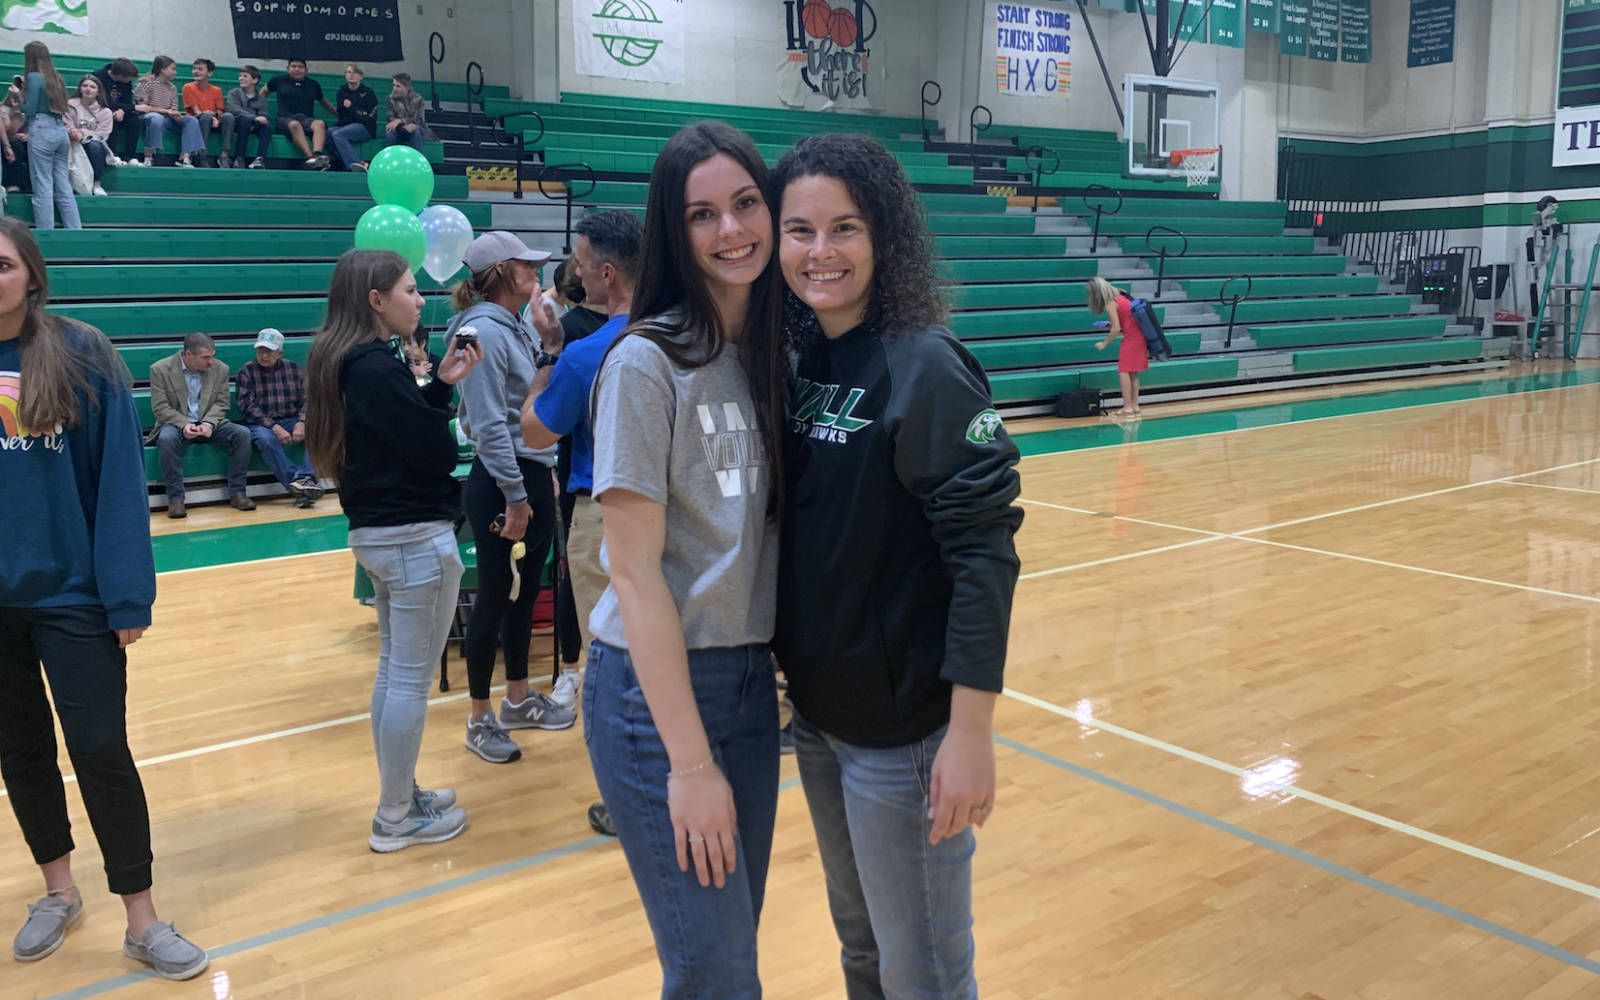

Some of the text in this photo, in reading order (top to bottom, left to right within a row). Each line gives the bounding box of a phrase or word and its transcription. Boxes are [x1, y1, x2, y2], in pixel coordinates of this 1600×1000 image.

[997, 4, 1071, 31] START STRONG
[998, 28, 1071, 54] FINISH STRONG
[803, 36, 861, 76] there
[822, 70, 840, 102] it
